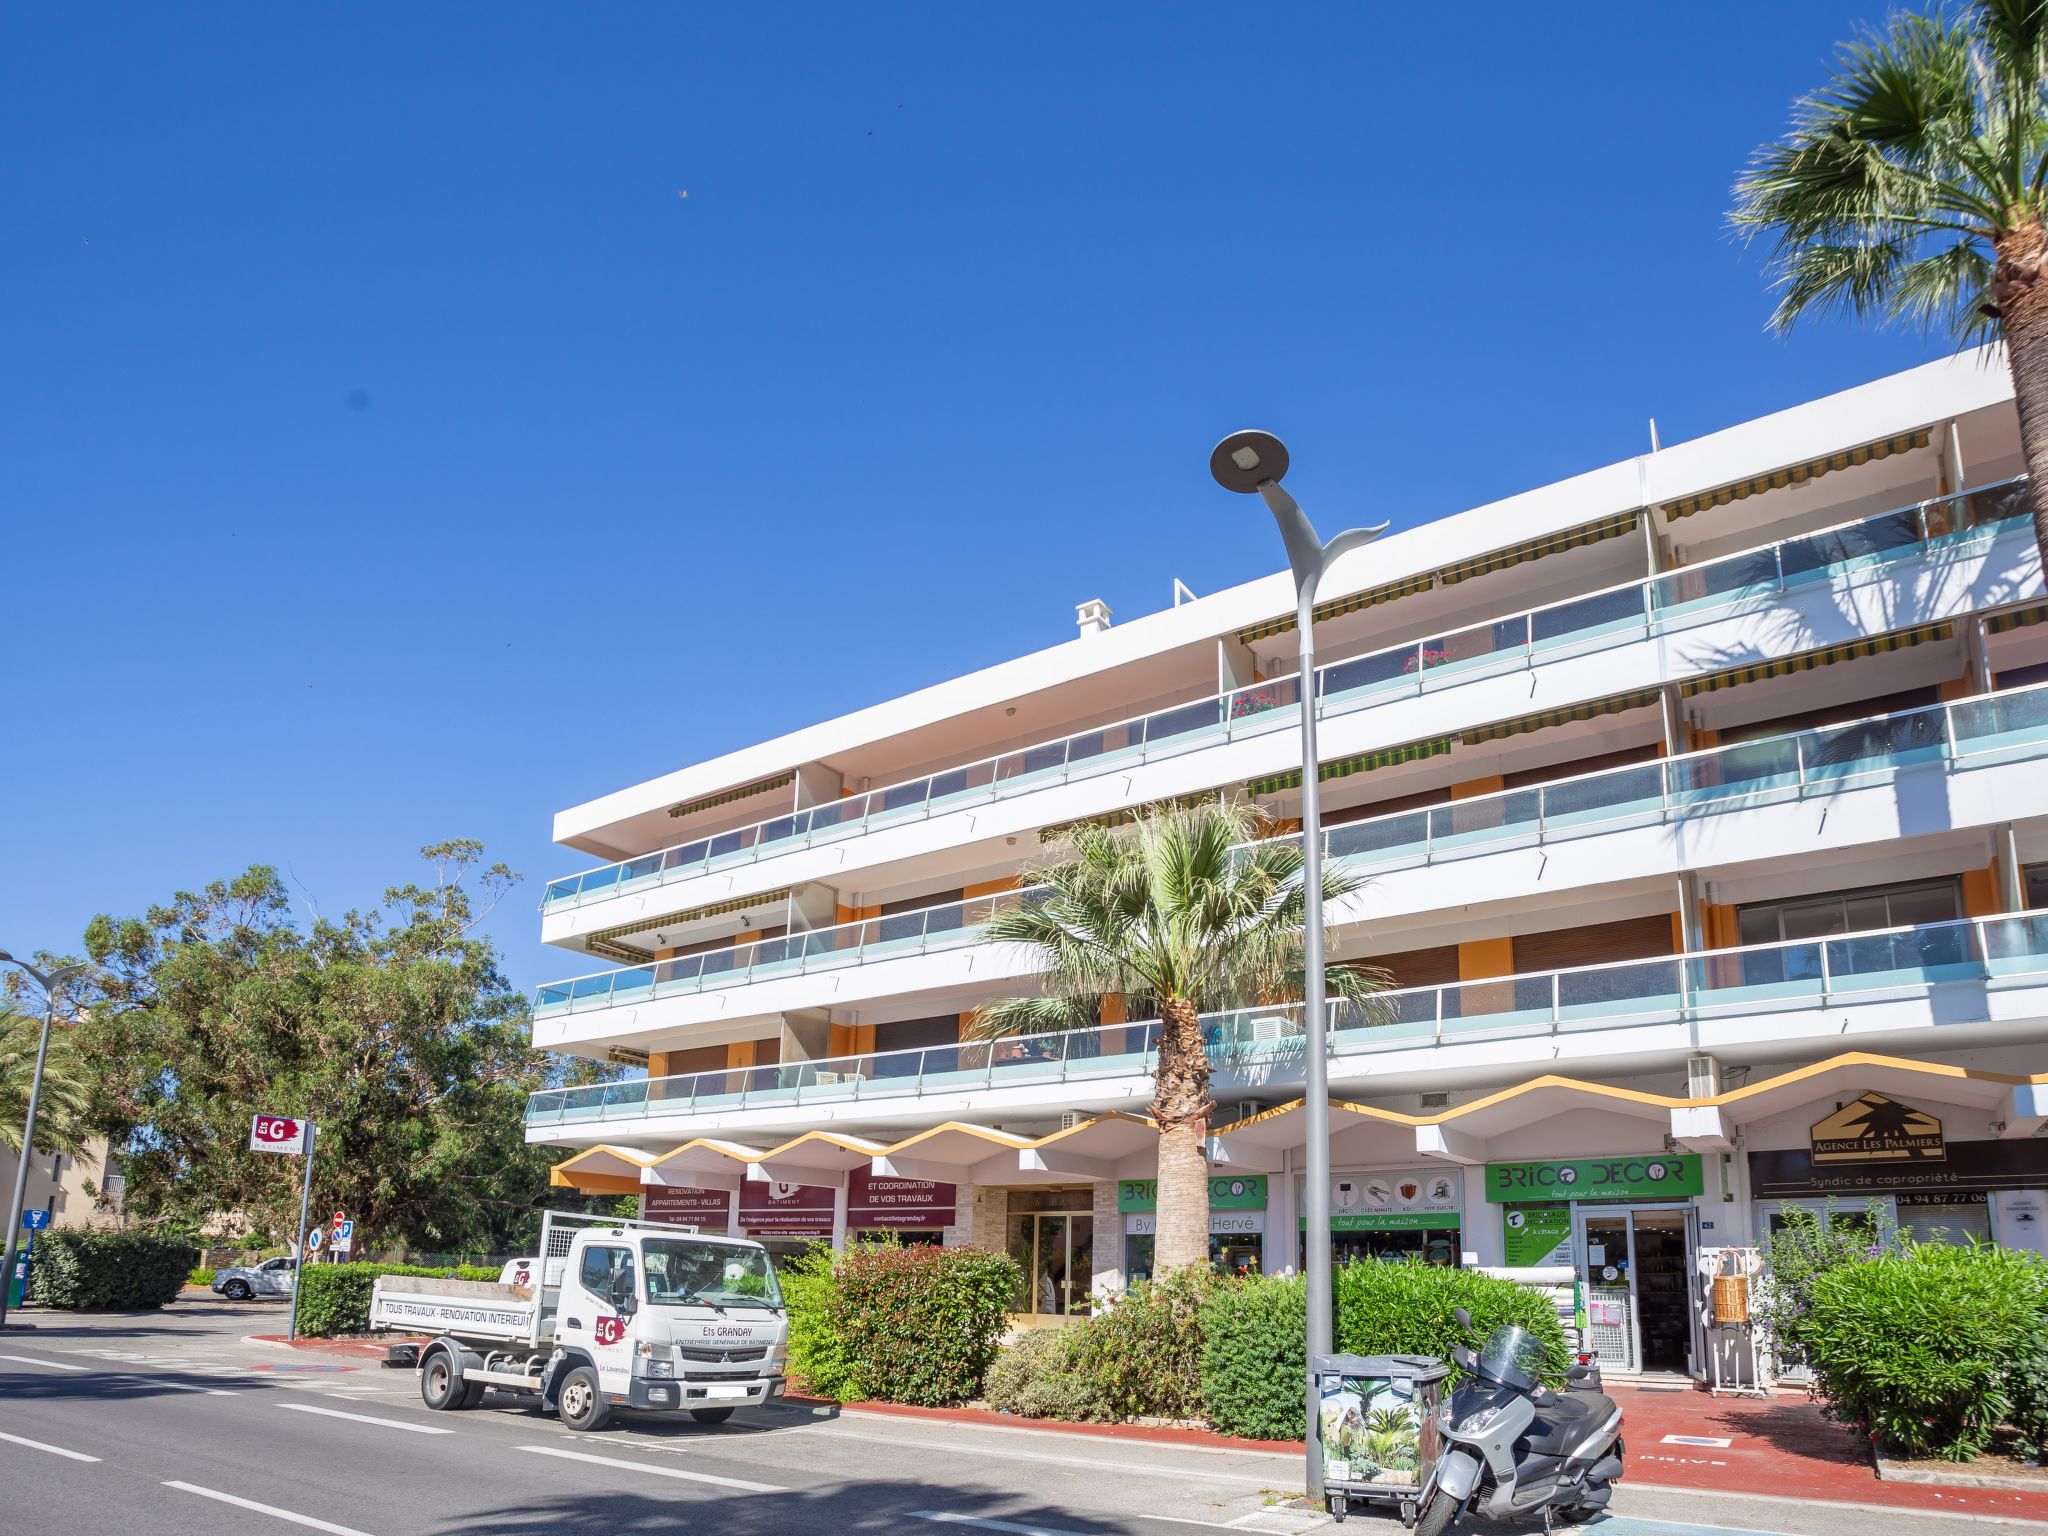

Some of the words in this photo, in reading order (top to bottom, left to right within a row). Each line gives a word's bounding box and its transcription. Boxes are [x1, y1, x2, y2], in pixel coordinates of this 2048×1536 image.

[270, 1120, 284, 1139] G
[1815, 1141, 1859, 1152] AGENCE
[1863, 1139, 1881, 1150] LES
[1885, 1137, 1941, 1149] PALMIERS
[1591, 1160, 1685, 1185] DECOR
[1810, 1176, 1850, 1188] Syndic
[1855, 1174, 1873, 1185] de
[1876, 1172, 1958, 1186] copropriété
[868, 1182, 877, 1190] ET
[878, 1181, 935, 1190] COORDINATION
[1552, 1189, 1567, 1198] tout
[1569, 1189, 1587, 1199] pour
[1590, 1187, 1598, 1196] la
[869, 1195, 879, 1203] DE
[880, 1195, 896, 1203] VOS
[897, 1194, 933, 1202] TRAVAUX
[1896, 1195, 1911, 1204] 04
[1914, 1194, 1929, 1204] 94
[1933, 1194, 1948, 1203] 87
[1952, 1193, 1967, 1203] 77
[1970, 1193, 1987, 1202] 06
[1135, 1218, 1150, 1233] By
[1212, 1216, 1254, 1230] Hervé
[1338, 1216, 1353, 1226] tout
[1355, 1218, 1375, 1228] pour
[1378, 1215, 1386, 1225] la
[1389, 1217, 1419, 1225] maison
[385, 1303, 403, 1314] TOUS
[404, 1305, 436, 1318] TRAVAUX
[440, 1308, 487, 1322] RENOVATION
[605, 1320, 616, 1342] G
[703, 1326, 715, 1337] Ets
[717, 1327, 753, 1337] GRANDAY
